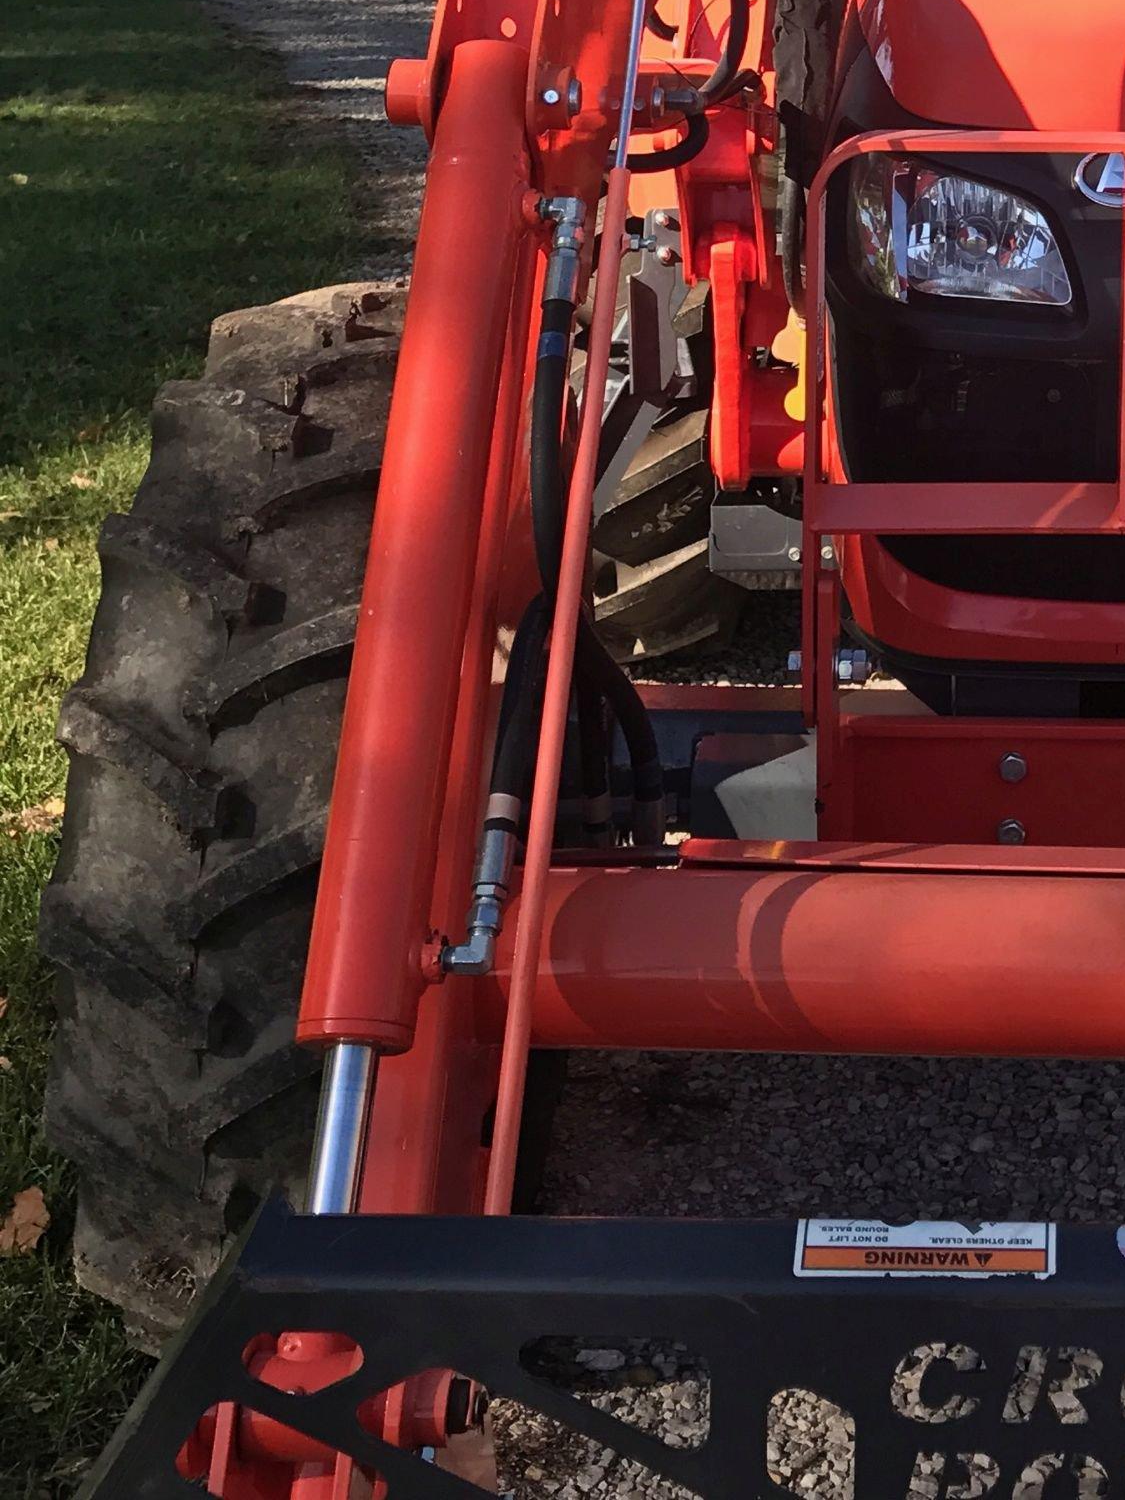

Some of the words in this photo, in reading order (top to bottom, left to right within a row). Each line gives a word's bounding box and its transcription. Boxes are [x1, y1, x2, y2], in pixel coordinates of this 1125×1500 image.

[828, 1235, 849, 1243] LIFT
[852, 1235, 872, 1243] NOT
[875, 1235, 889, 1243] DO
[966, 1237, 1005, 1245] OTHERS
[1007, 1237, 1033, 1245] KEEP
[864, 1251, 969, 1266] WARNING
